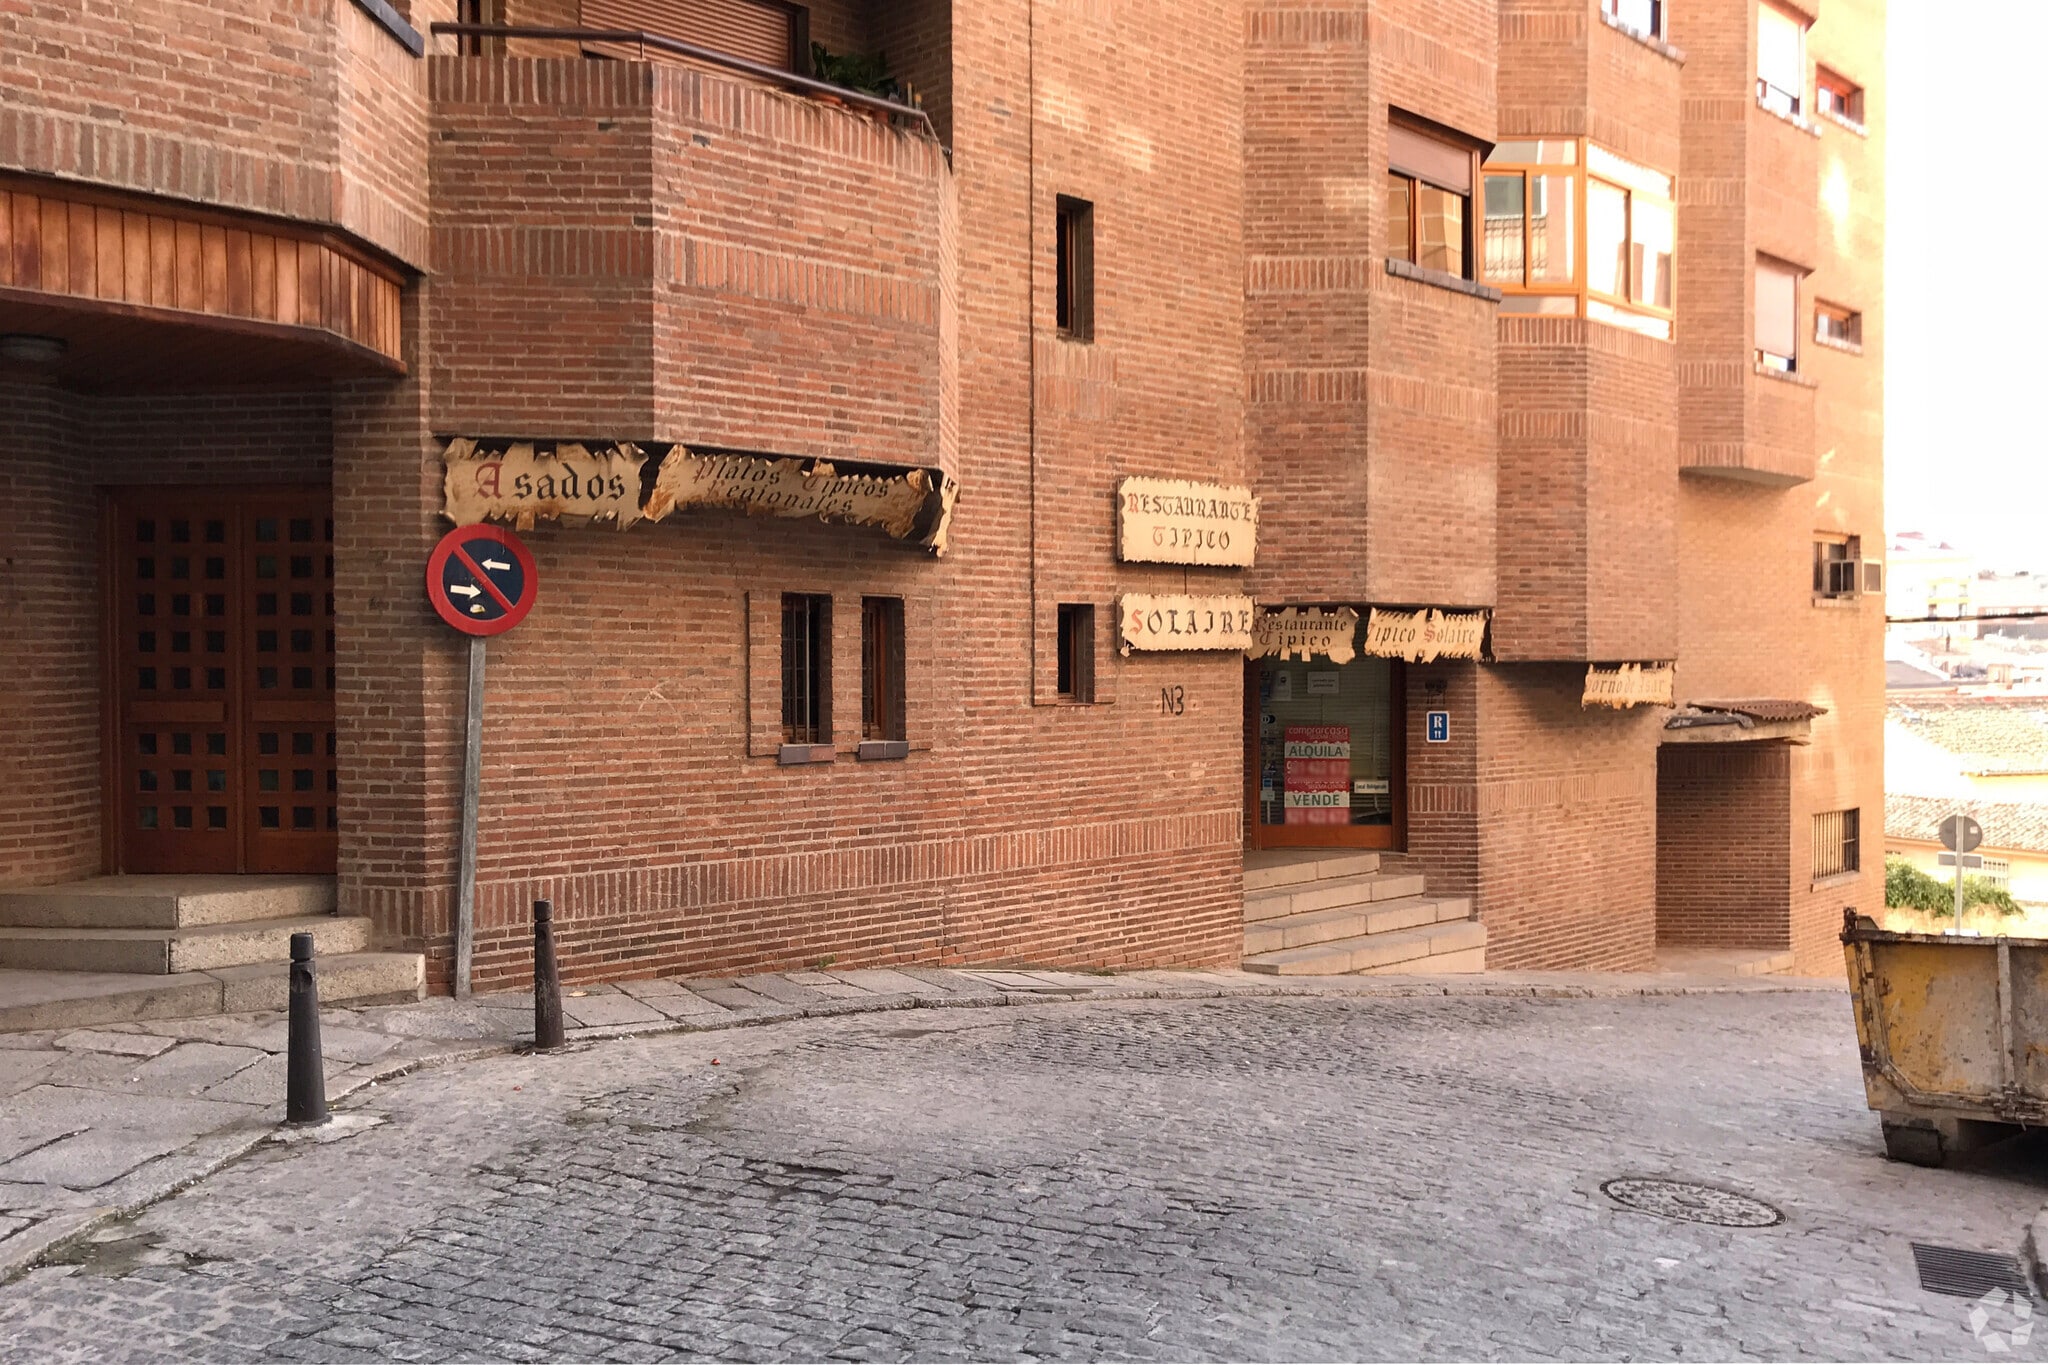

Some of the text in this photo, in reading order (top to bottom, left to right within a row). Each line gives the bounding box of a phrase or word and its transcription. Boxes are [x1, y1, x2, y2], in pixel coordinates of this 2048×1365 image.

[473, 461, 626, 502] Asados
[693, 460, 780, 485] Platos
[706, 479, 852, 513] Regionales
[1127, 492, 1252, 523] RESTAURANTE
[1152, 526, 1230, 550] TIPICO
[1130, 609, 1252, 636] SOLAIRE
[1253, 616, 1348, 633] Restaurante
[1260, 630, 1331, 648] Tipico
[1423, 623, 1476, 643] Solaire
[1587, 678, 1622, 694] orno
[1433, 715, 1443, 728] R
[1289, 745, 1343, 759] ALQUILA
[1293, 794, 1340, 807] VENDE
